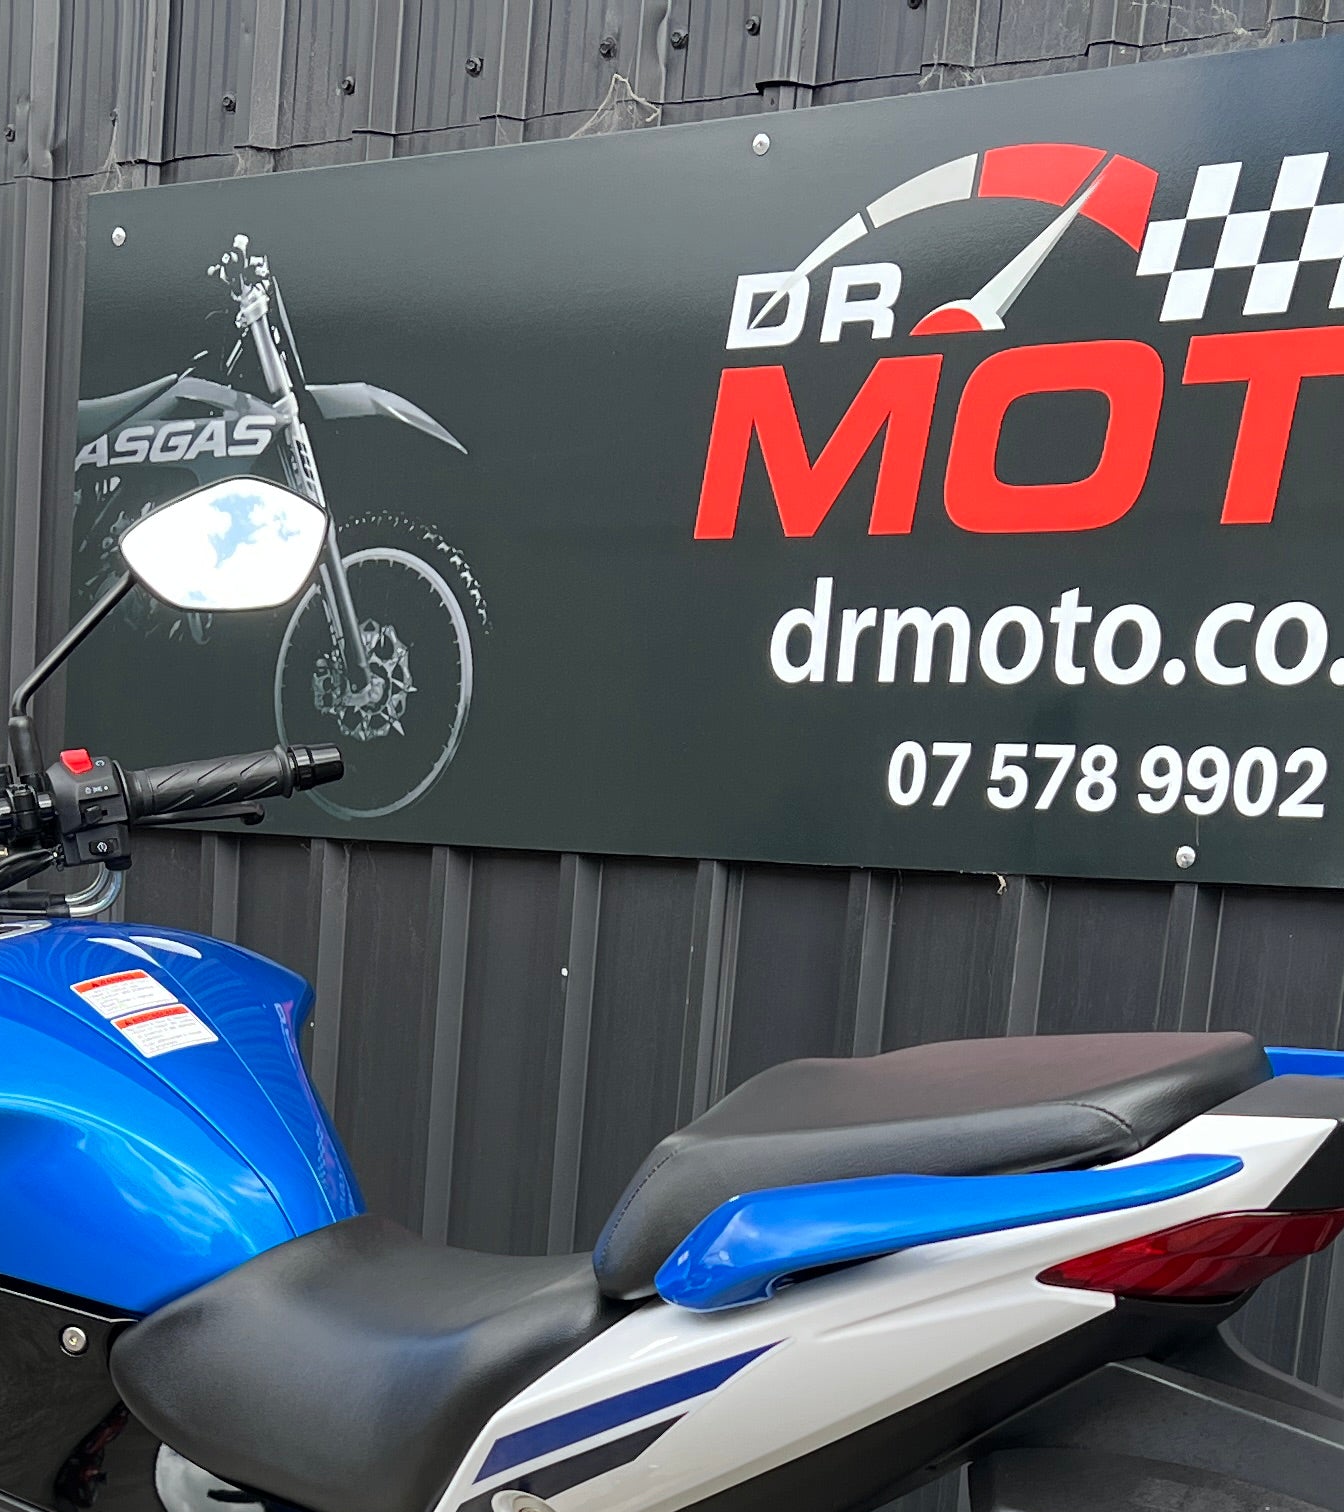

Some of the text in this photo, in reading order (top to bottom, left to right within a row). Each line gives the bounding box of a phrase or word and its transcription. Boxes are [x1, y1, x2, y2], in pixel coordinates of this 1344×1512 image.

[726, 262, 902, 350] DR
[887, 740, 1328, 818] 07 578 9902
